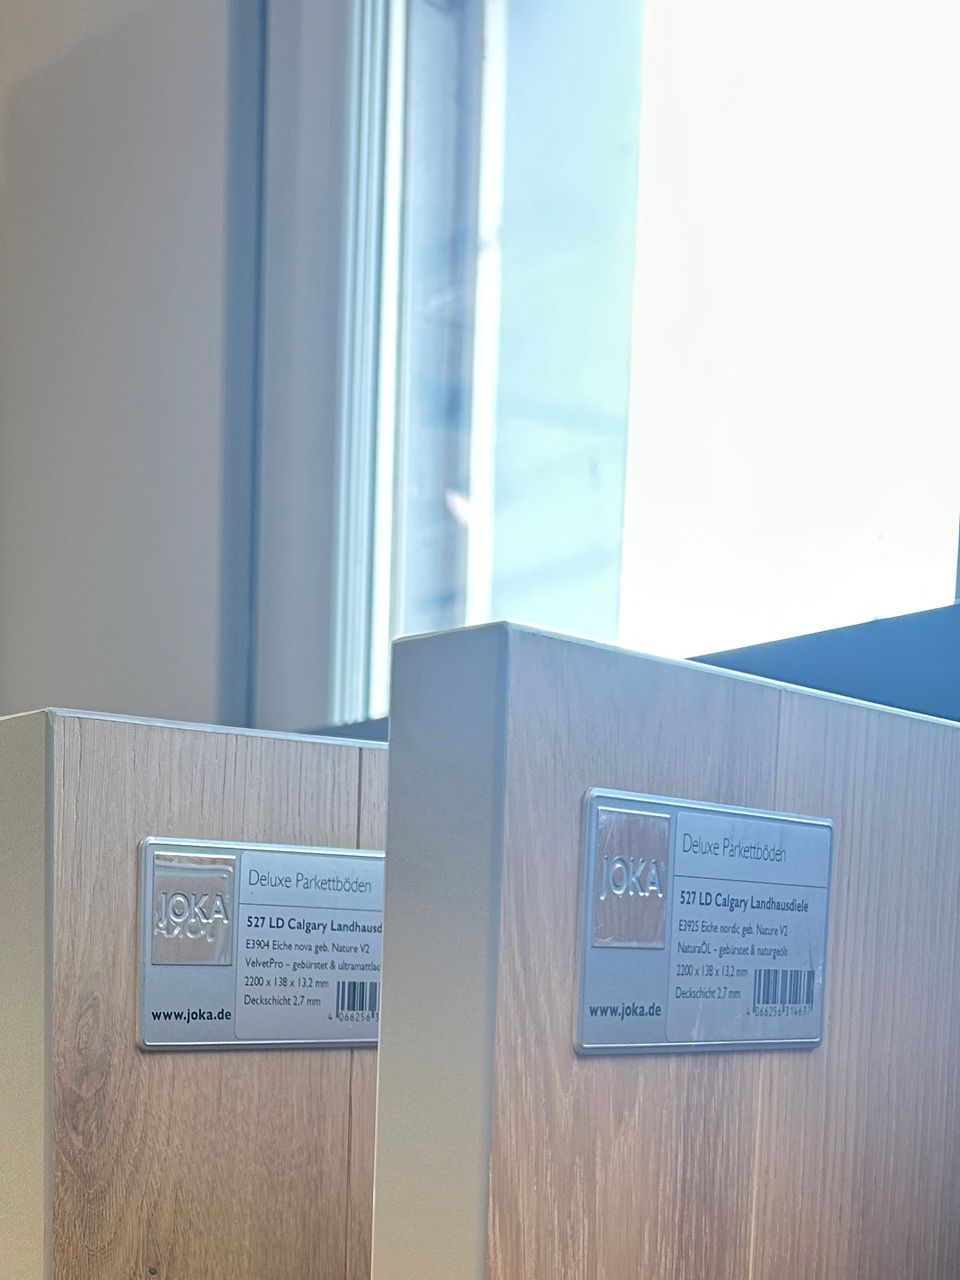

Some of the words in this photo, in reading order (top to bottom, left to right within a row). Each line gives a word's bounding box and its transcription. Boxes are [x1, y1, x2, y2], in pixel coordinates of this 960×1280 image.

[682, 833, 720, 856] Deluxe
[722, 837, 787, 862] Parkettböden
[248, 869, 292, 889] Deluxe
[296, 872, 372, 893] Parkettböden
[600, 854, 664, 901] JOKA
[158, 891, 229, 928] JOKA
[679, 890, 697, 905] 527
[699, 891, 713, 907] LD
[715, 892, 749, 913] Calgary
[750, 895, 809, 913] Landhausdiele
[246, 915, 266, 928] 527
[269, 917, 285, 929] LD
[288, 917, 328, 935] Calgary
[701, 920, 719, 933] Eiche
[720, 922, 740, 935] nordic
[780, 925, 788, 937] V2
[245, 939, 270, 950] E3904
[272, 940, 293, 951] Eiche
[294, 942, 313, 952] nova
[314, 942, 329, 955] geb.
[331, 942, 358, 954] Nature
[360, 943, 370, 954] V2
[750, 944, 755, 956] &
[245, 957, 284, 969] VelvetPro
[292, 959, 328, 972] gebürstet
[329, 959, 336, 970] &
[676, 964, 694, 977] 2200
[694, 967, 700, 977] x
[714, 968, 720, 977] x
[244, 976, 265, 987] 2200
[266, 979, 271, 987] x
[274, 977, 288, 987] 138
[289, 980, 295, 988] x
[298, 977, 313, 988] 13,2
[315, 980, 329, 988] mm
[243, 994, 291, 1006] Deckschicht
[293, 995, 305, 1007] 2,7
[306, 998, 321, 1006] mm
[675, 986, 716, 1000] Deckschicht
[151, 1009, 233, 1023] www.joka.de
[589, 1003, 662, 1020] www.joka.de
